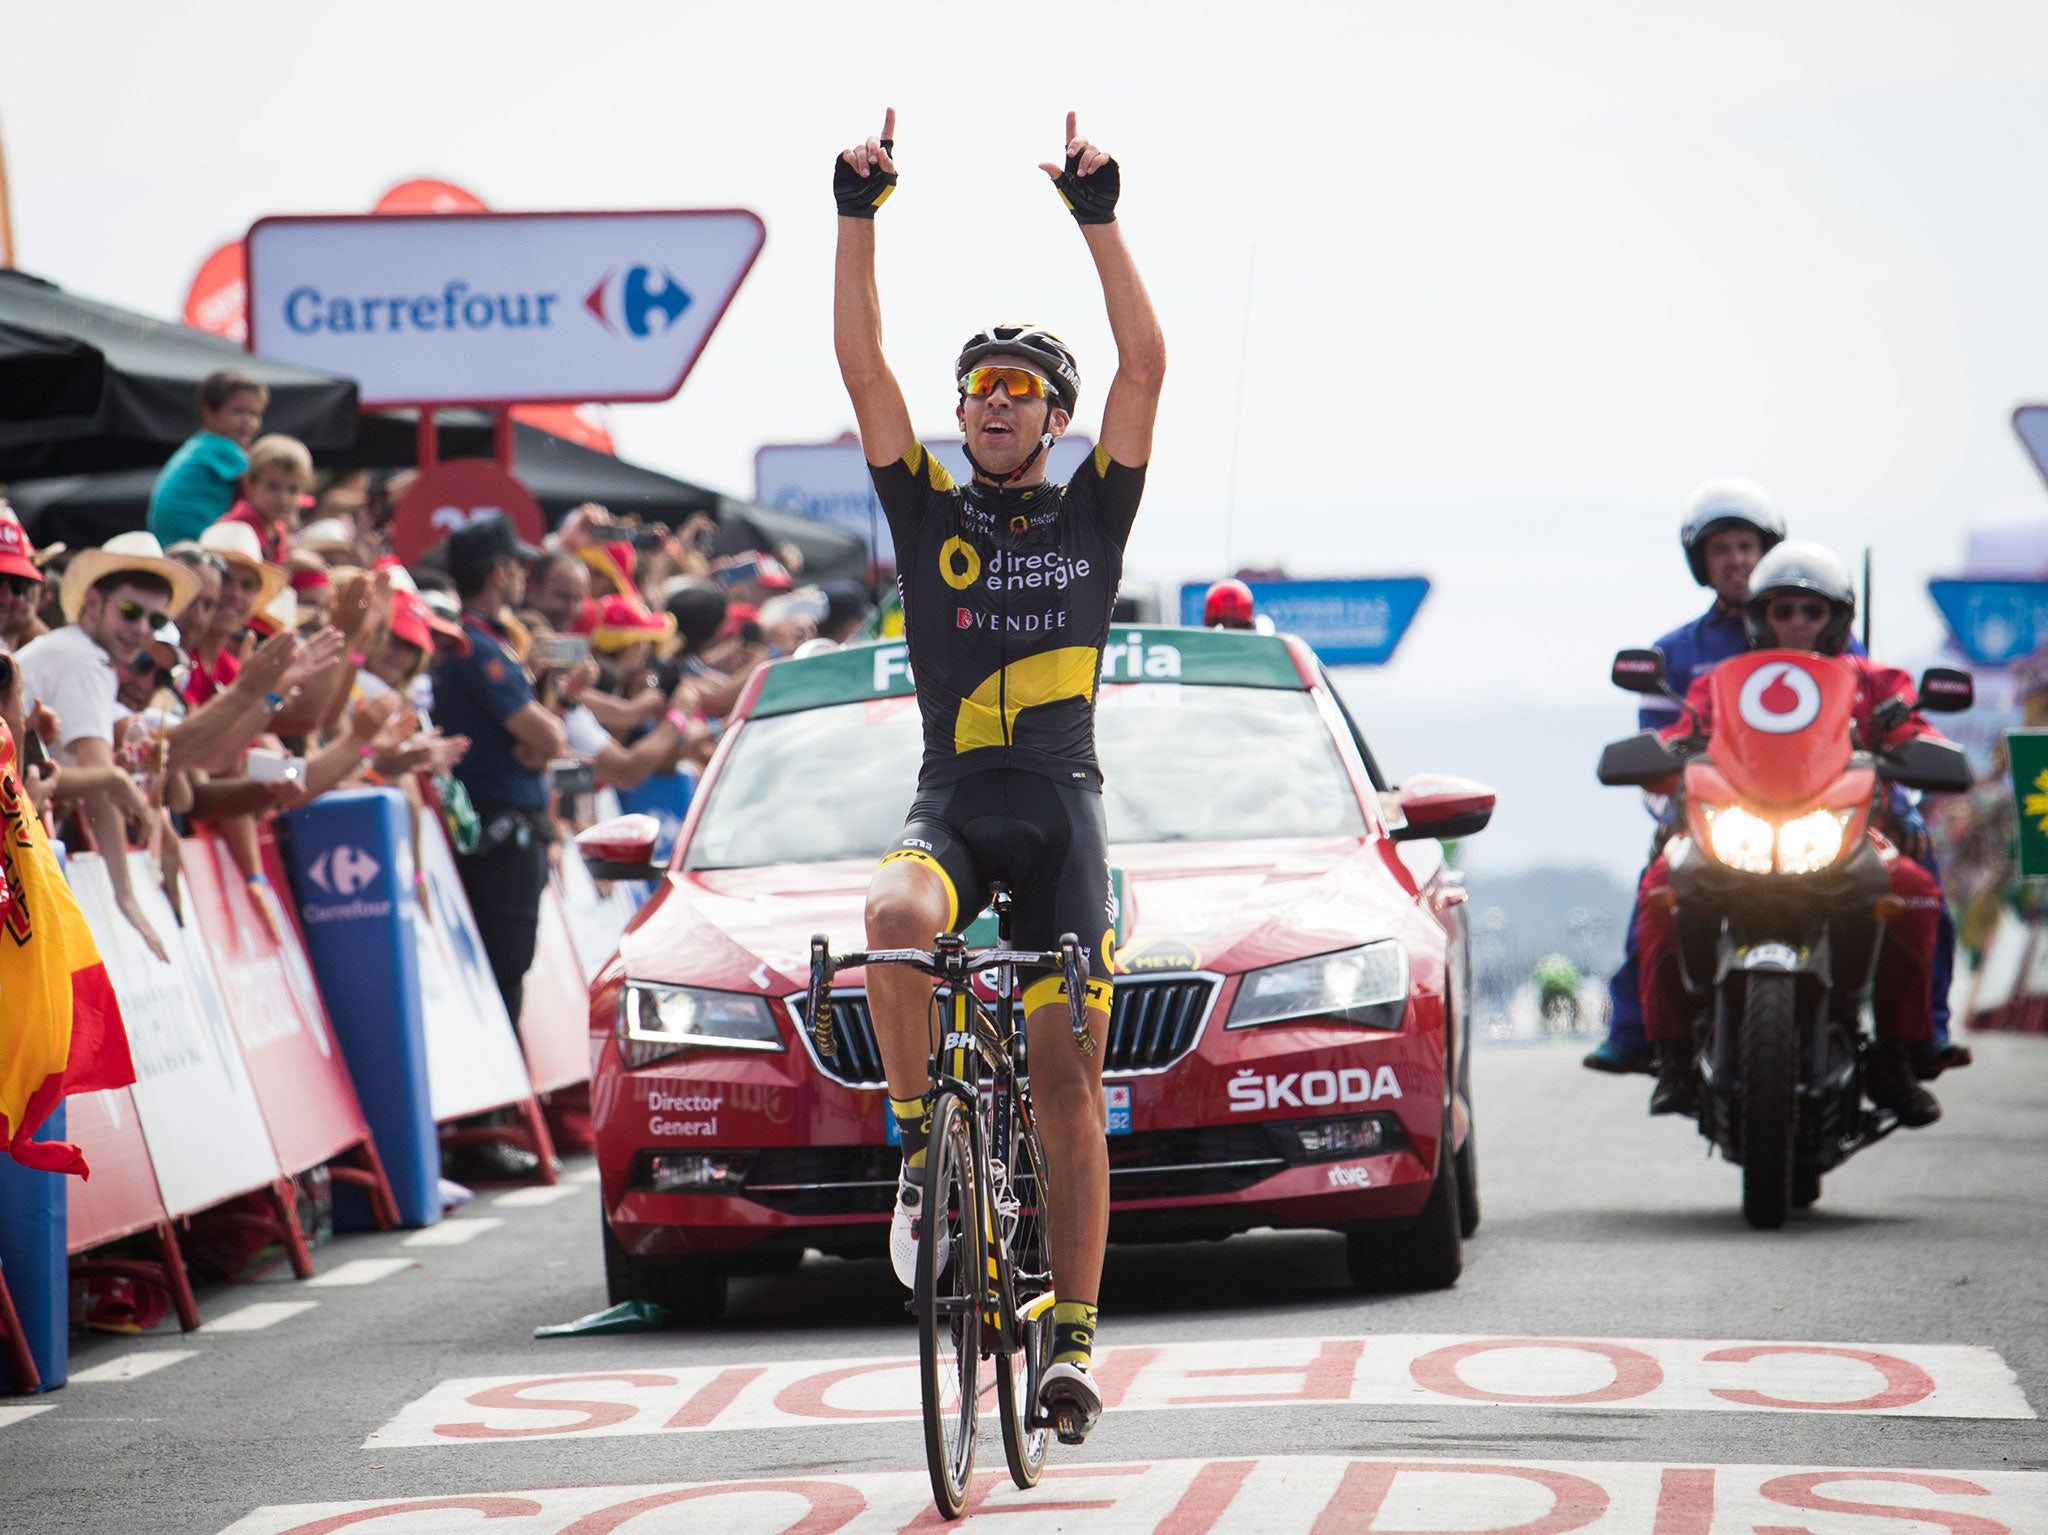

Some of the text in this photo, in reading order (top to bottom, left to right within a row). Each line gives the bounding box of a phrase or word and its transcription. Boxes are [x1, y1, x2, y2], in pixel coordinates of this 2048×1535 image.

[284, 281, 557, 334] Carrefour
[986, 559, 1091, 590] energie
[976, 609, 1066, 632] VENDÉE
[945, 1032, 977, 1051] BH
[1227, 1065, 1404, 1113] ŠKODA
[648, 1090, 724, 1112] Director
[648, 1114, 718, 1136] General
[1327, 1164, 1371, 1188] rtve
